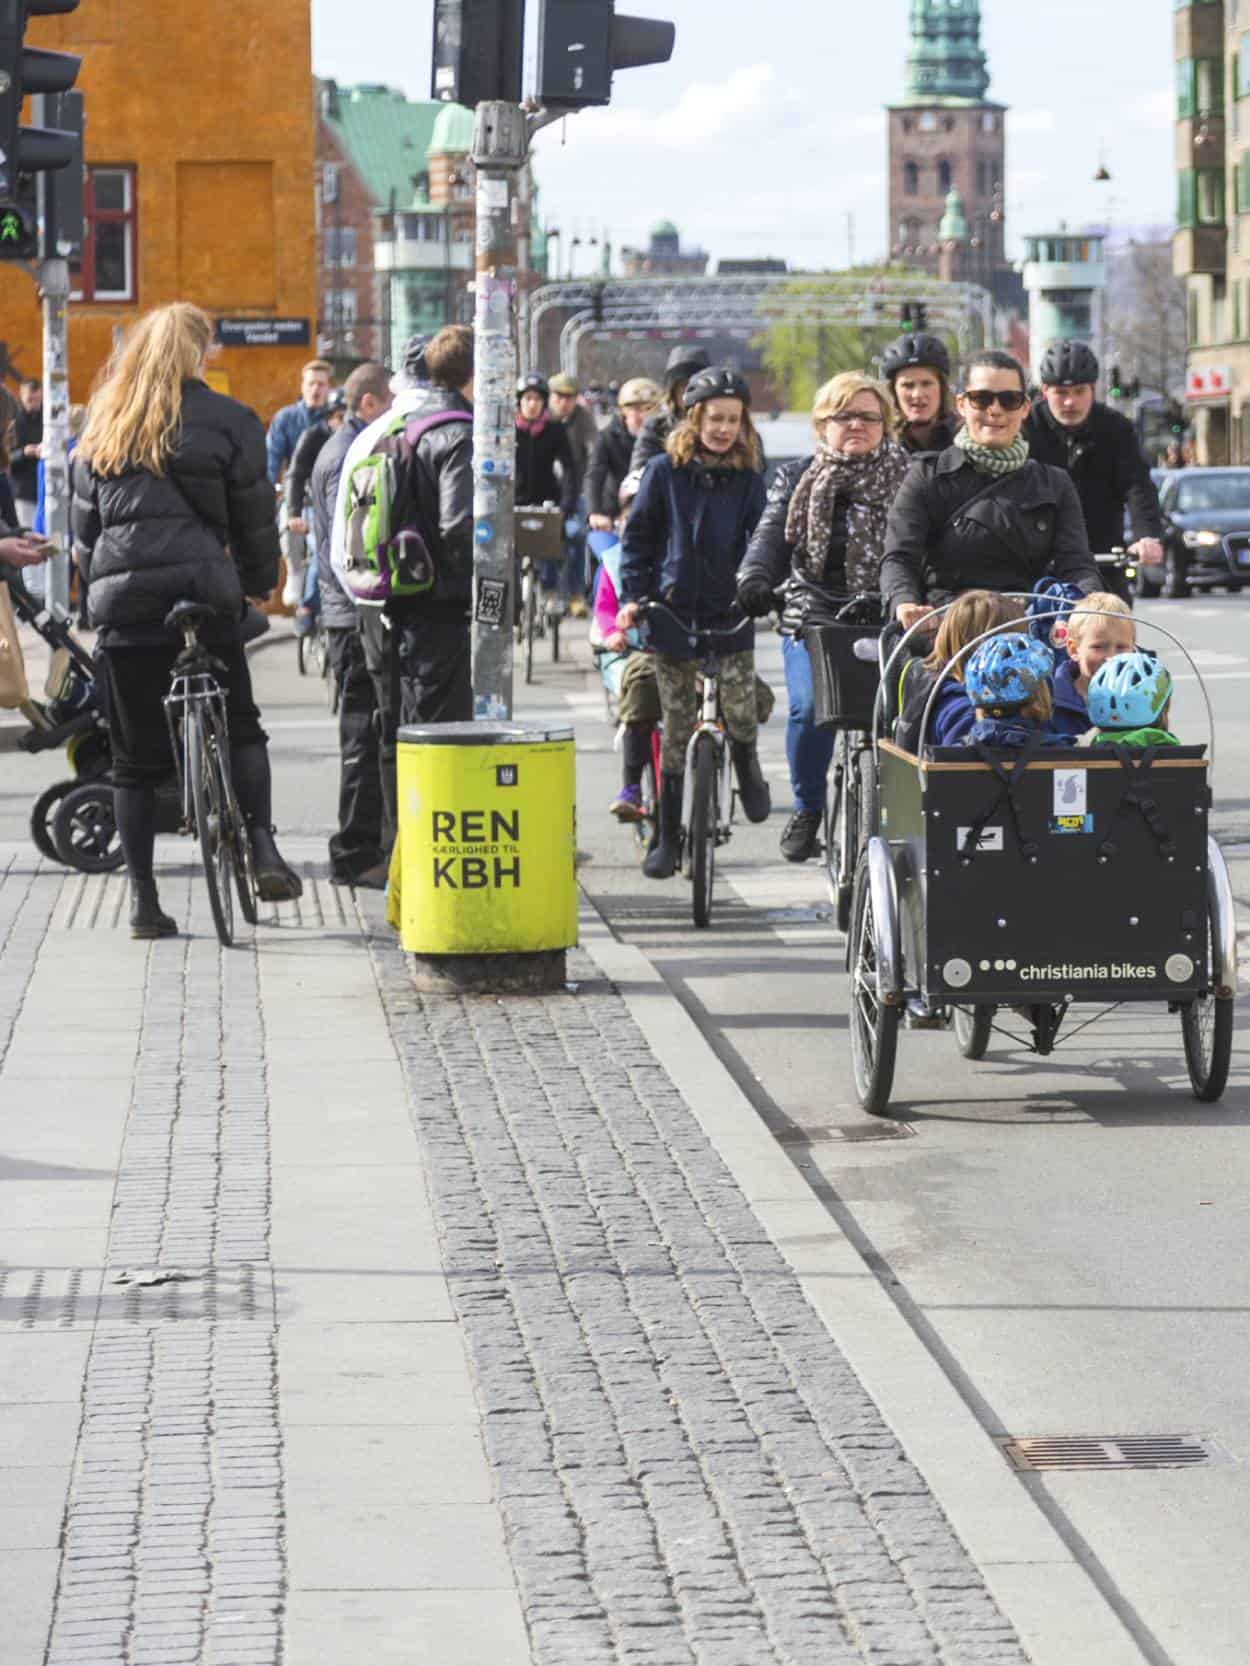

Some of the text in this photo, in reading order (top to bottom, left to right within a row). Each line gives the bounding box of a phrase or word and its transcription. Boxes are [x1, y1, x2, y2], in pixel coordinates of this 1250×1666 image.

[432, 810, 519, 842] REN
[503, 844, 520, 853] TIL
[433, 856, 520, 889] KBH
[1020, 962, 1157, 980] christiania bikes
